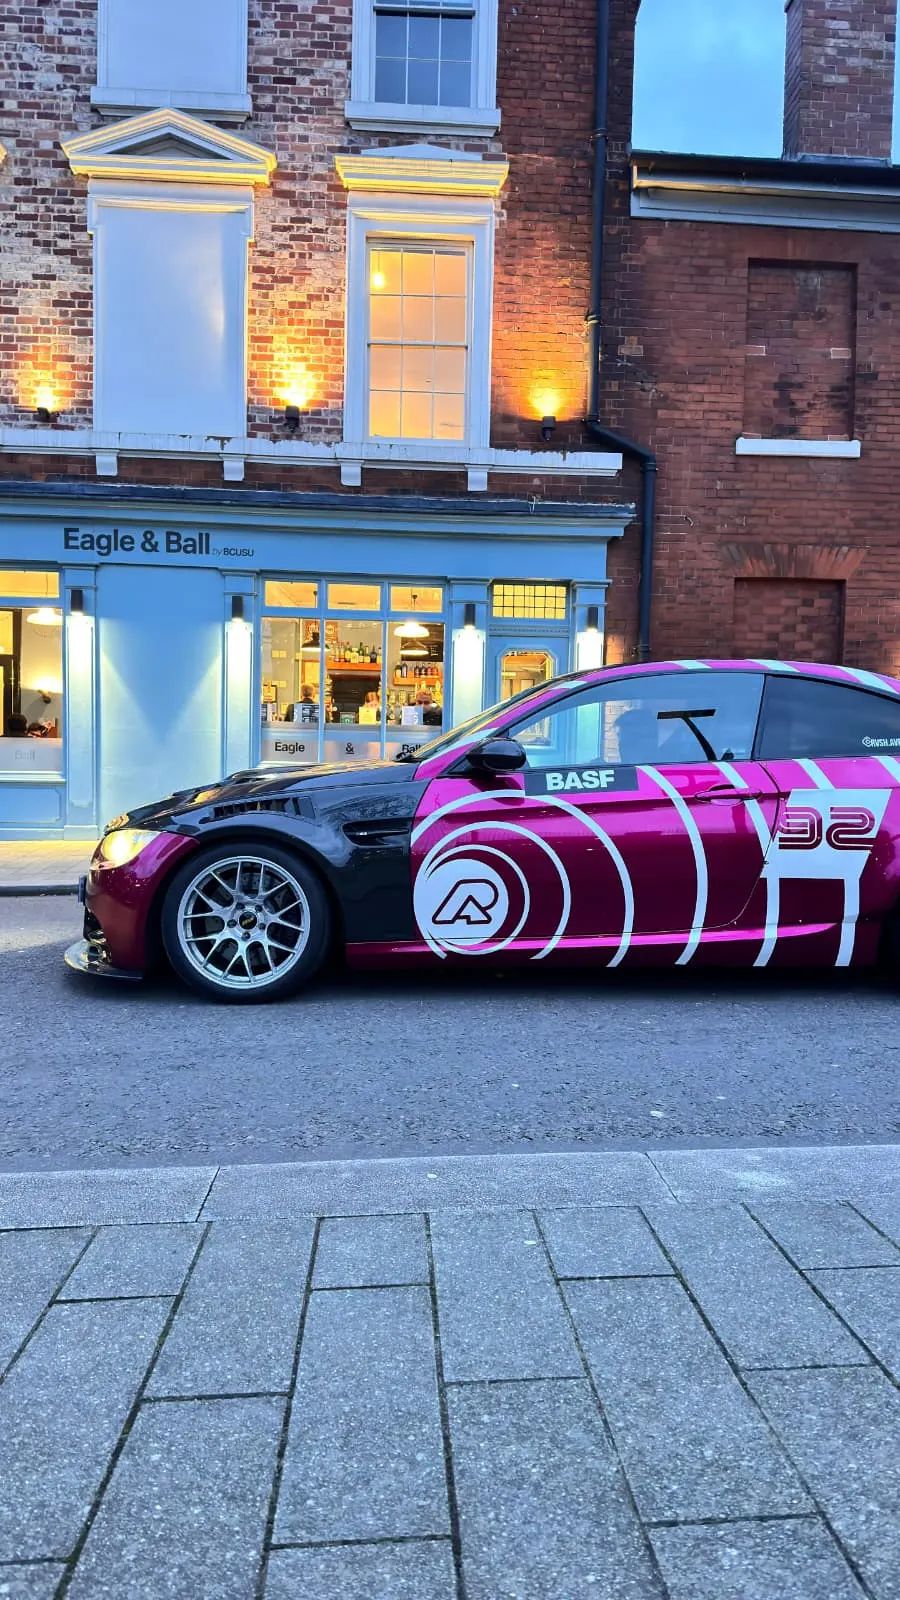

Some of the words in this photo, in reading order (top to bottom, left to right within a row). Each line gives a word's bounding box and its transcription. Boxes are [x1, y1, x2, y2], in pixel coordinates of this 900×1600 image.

[63, 527, 135, 556] Eagle
[140, 530, 160, 553] &
[165, 531, 210, 555] Ball
[212, 547, 222, 557] by
[223, 547, 255, 557] BCUSU
[274, 741, 305, 754] Eagle
[345, 742, 354, 754] &
[545, 769, 615, 791] BASF
[778, 806, 877, 851] 92
